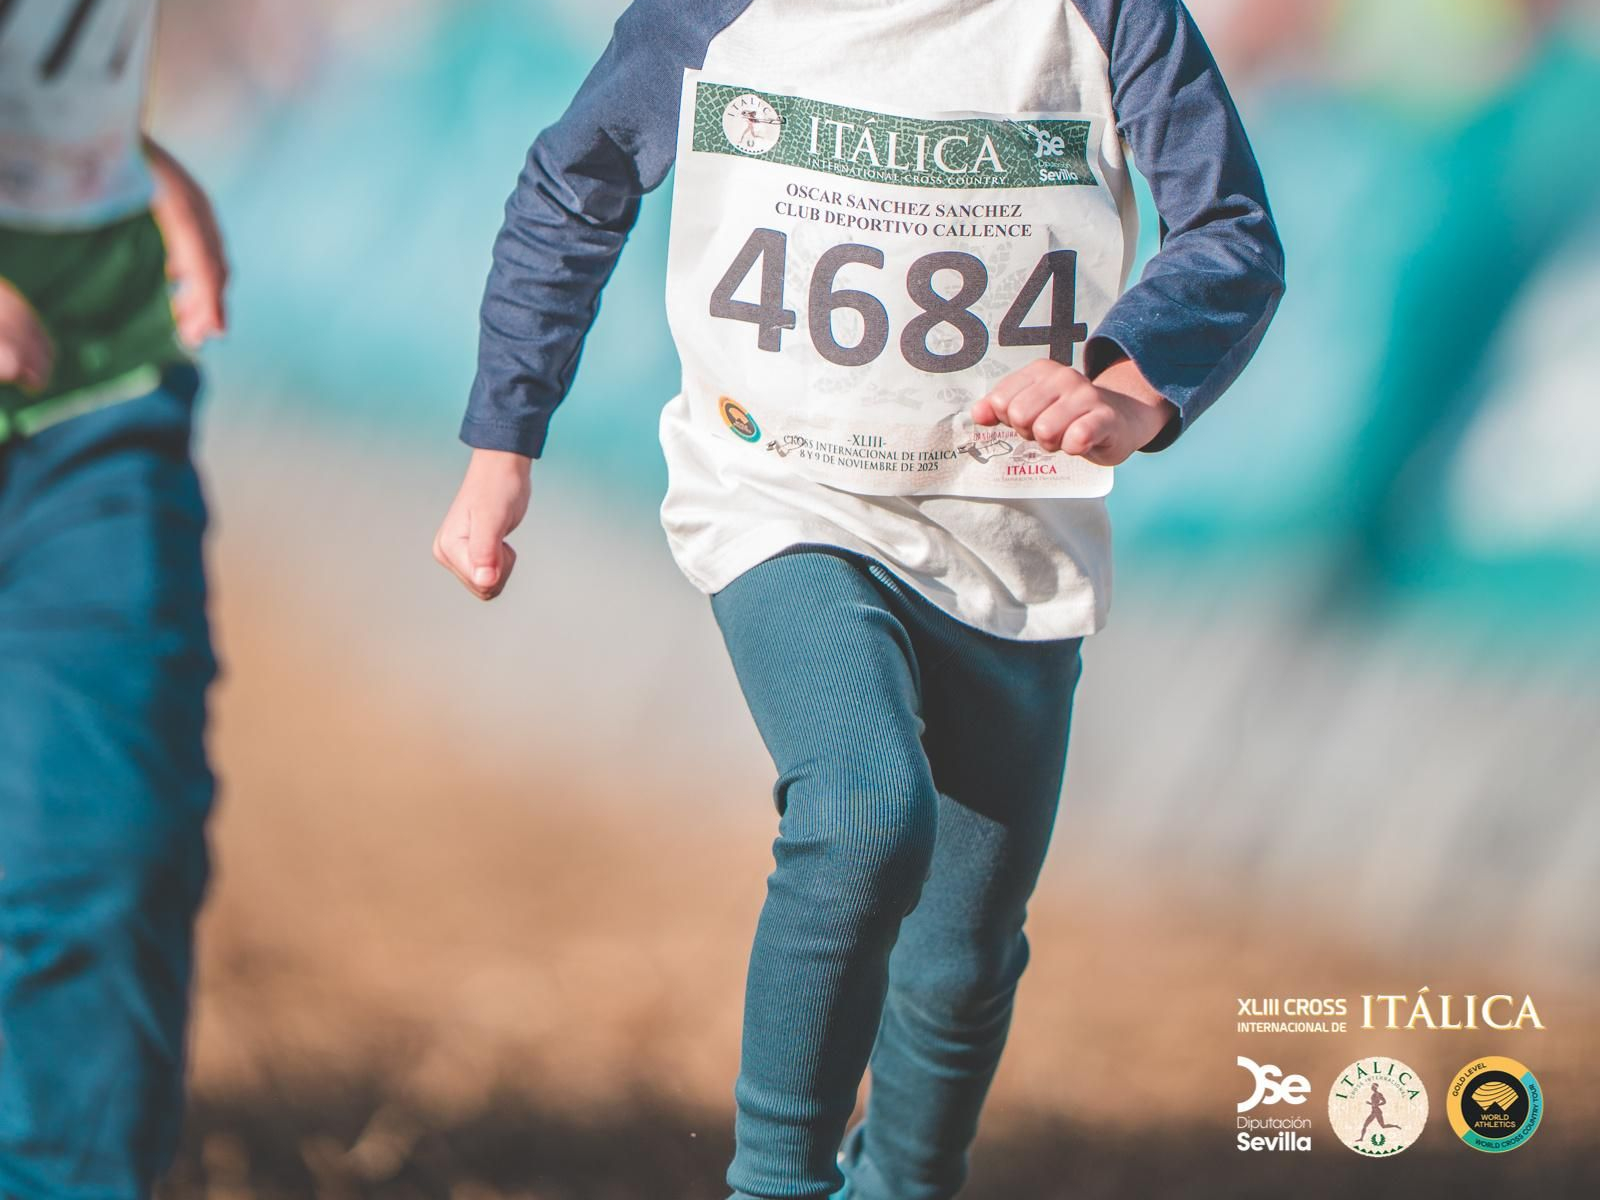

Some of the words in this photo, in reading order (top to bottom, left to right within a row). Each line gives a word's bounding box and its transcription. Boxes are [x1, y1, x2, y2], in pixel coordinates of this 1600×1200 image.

[808, 116, 1007, 174] ITÁLICA
[808, 157, 899, 181] INTERNATIONAL
[905, 175, 943, 185] CROSS
[948, 175, 1007, 185] COUNTRY
[1039, 169, 1078, 182] Sevilla
[786, 183, 842, 205] OSCAR
[847, 194, 930, 217] SANCHEZ
[935, 204, 1022, 218] SANCHEZ
[775, 201, 820, 221] CLUB
[825, 210, 928, 237] DEPORTIVO
[933, 224, 1032, 237] CALLENCE
[710, 227, 1088, 374] 4684
[783, 435, 814, 449] CROSS
[816, 441, 899, 461] INTERNACIONAL
[902, 452, 915, 461] DE
[823, 454, 836, 464] DE
[838, 457, 898, 472] NOVIEMBRE
[901, 461, 915, 472] DE
[917, 461, 939, 472] 2025
[1007, 463, 1057, 475] ITÁLICA
